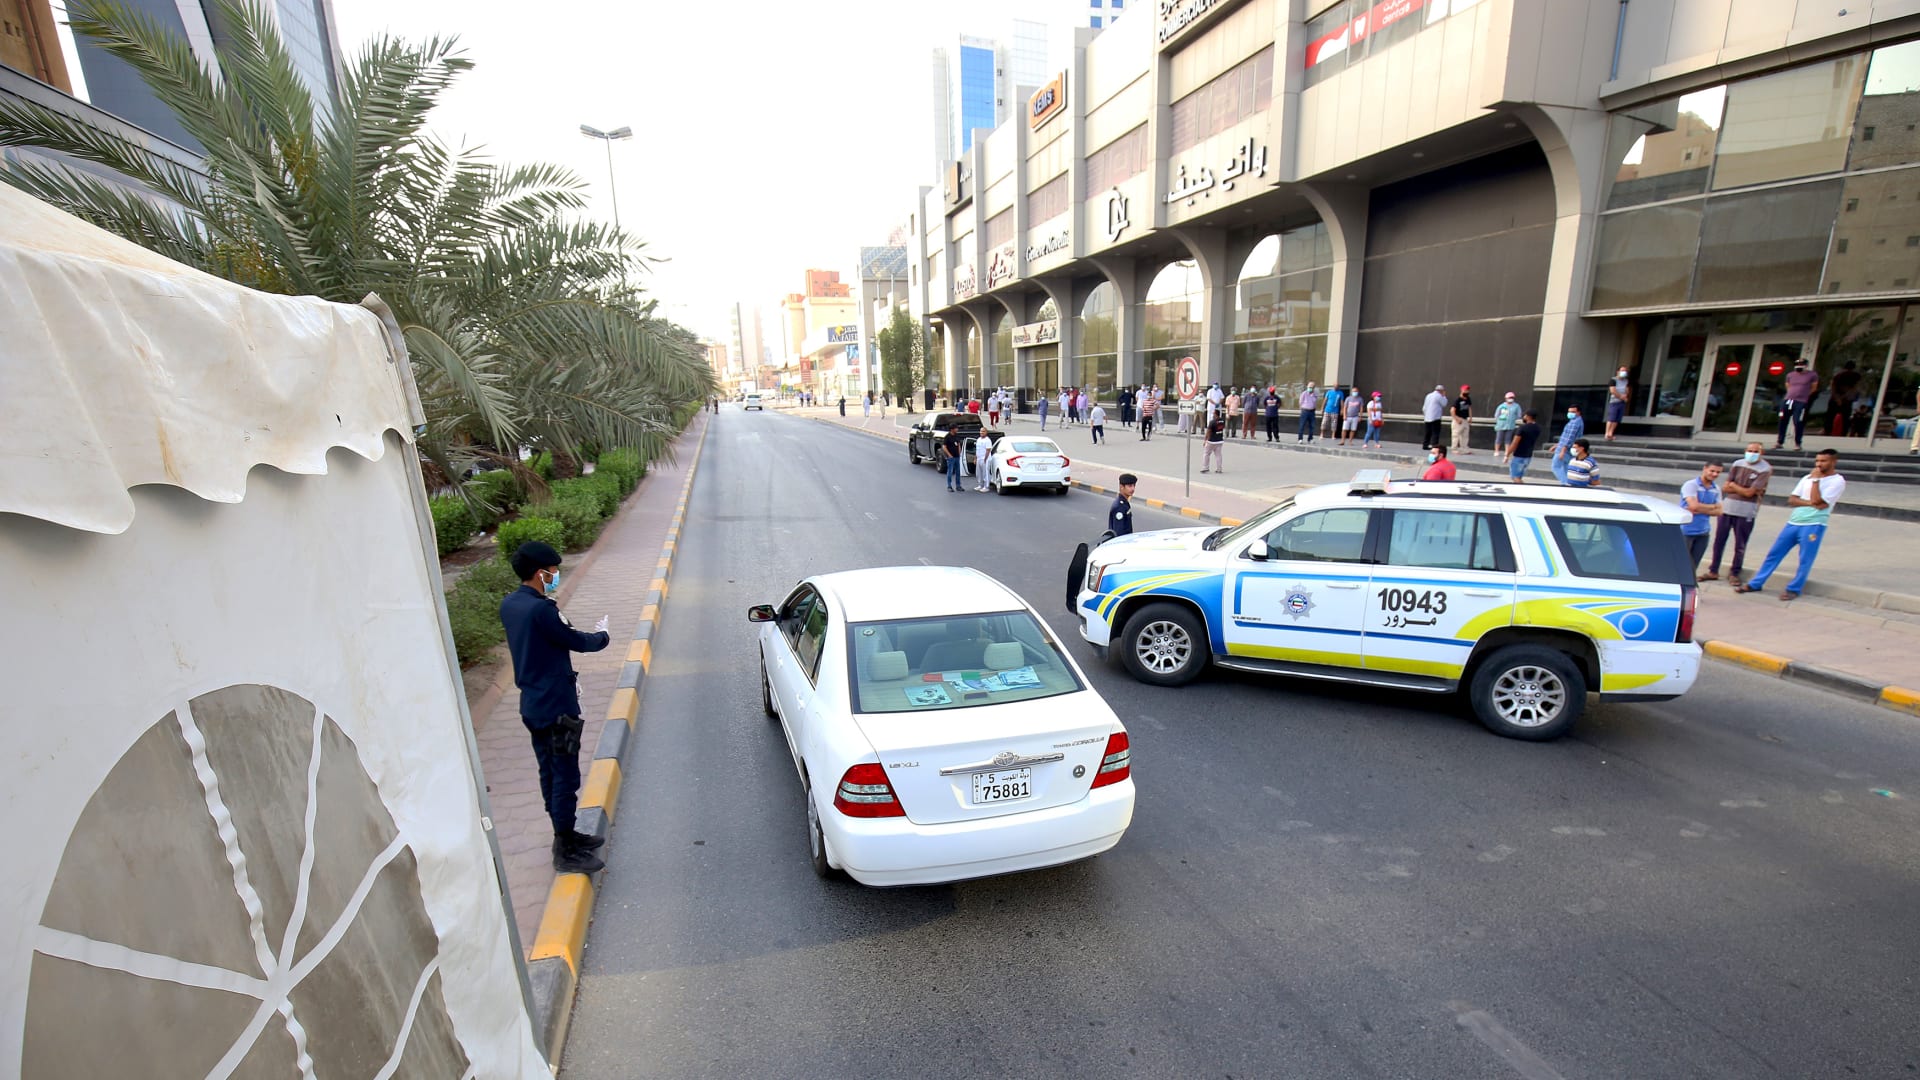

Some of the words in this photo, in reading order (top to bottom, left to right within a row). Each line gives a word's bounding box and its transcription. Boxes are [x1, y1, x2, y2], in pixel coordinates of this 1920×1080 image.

[1183, 367, 1195, 393] P
[1378, 588, 1447, 614] 10943
[1382, 615, 1437, 628] مرور
[988, 774, 995, 784] 5
[983, 782, 1029, 800] 75881
